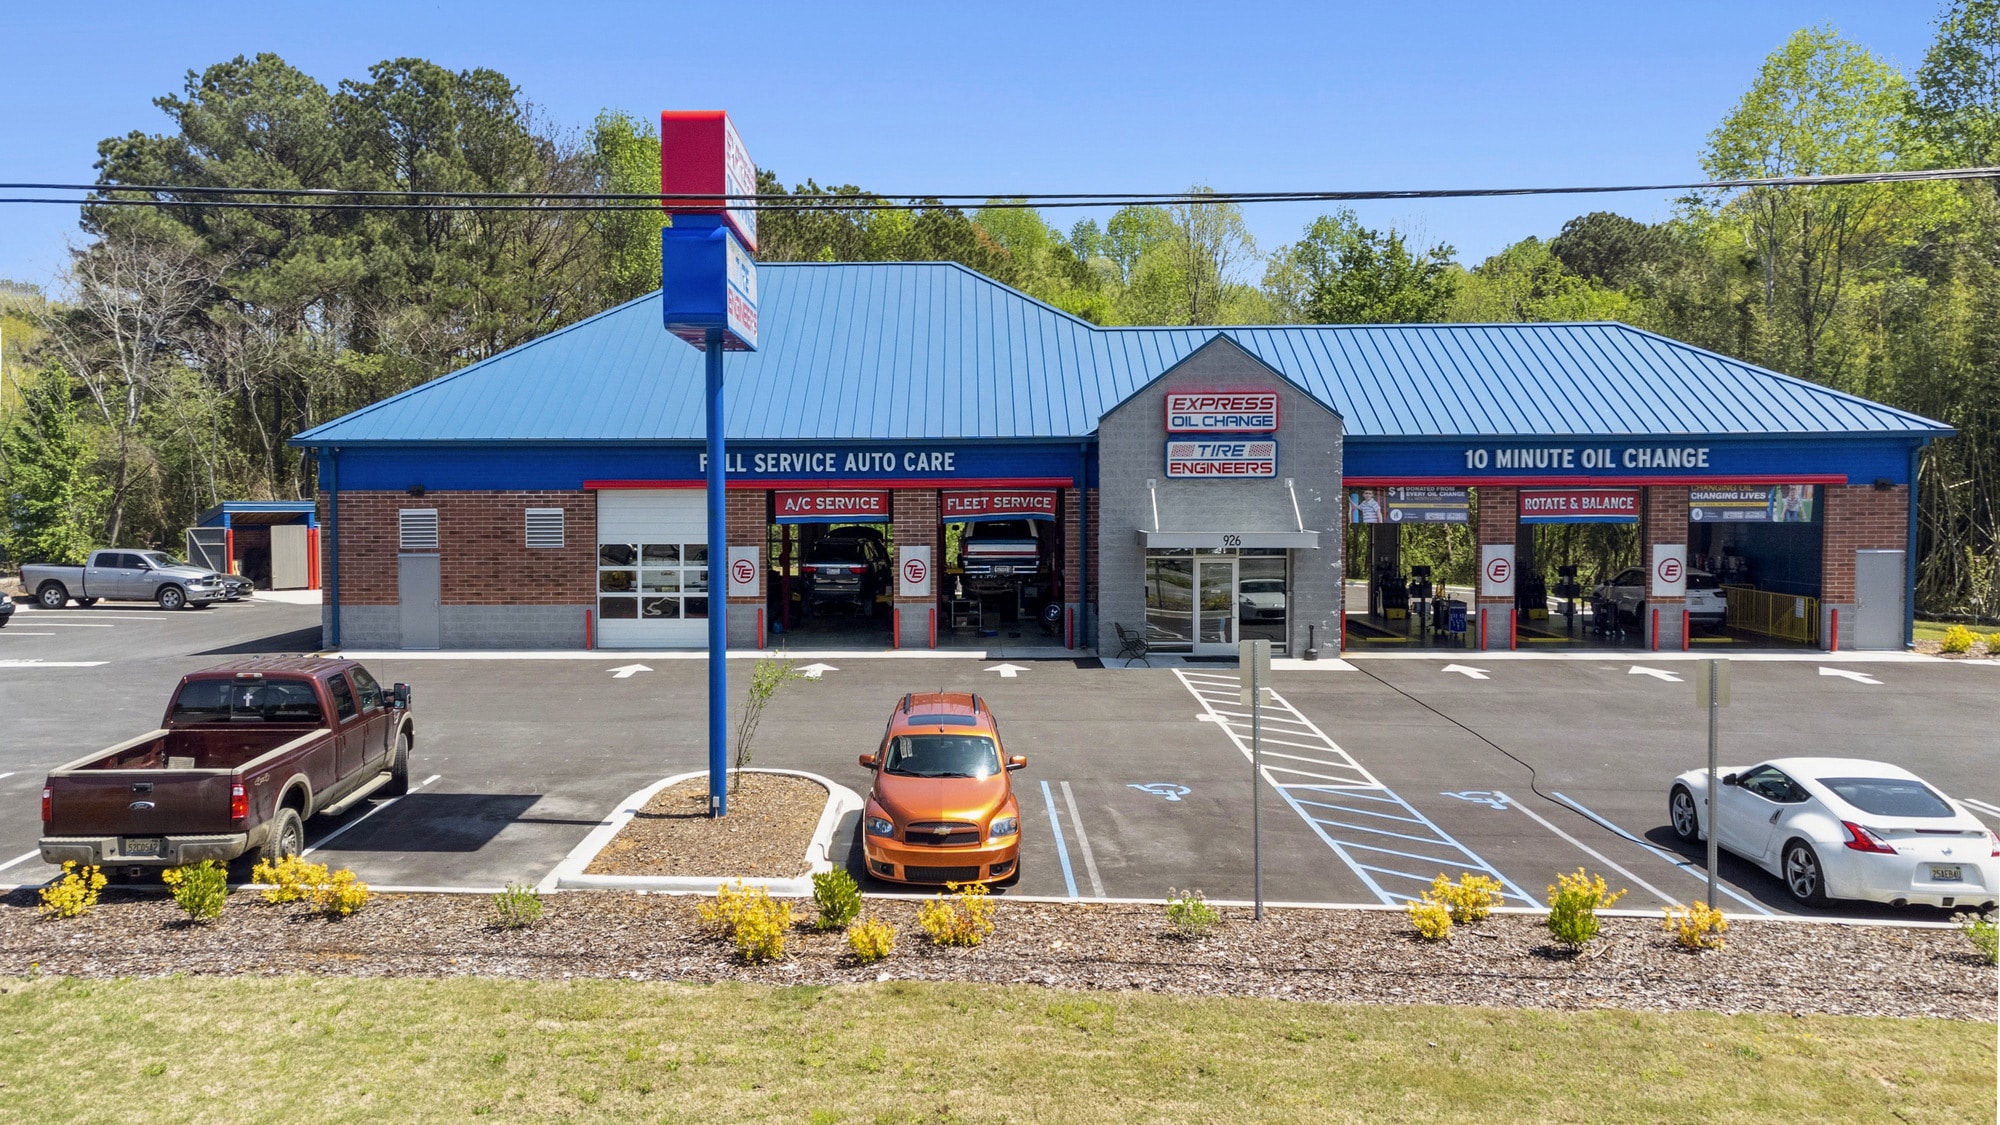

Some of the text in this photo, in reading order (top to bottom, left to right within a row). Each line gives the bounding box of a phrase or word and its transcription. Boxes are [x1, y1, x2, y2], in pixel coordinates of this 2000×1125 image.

[1172, 397, 1275, 410] EXPRESS
[1172, 415, 1274, 427] OIL CHANGE
[1198, 444, 1246, 457] TIRE
[699, 452, 955, 473] FLL SERVICE AUTO CARE
[1464, 448, 1710, 469] 10 MINUTE OIL CHANGE
[1170, 462, 1273, 474] ENGINEERS
[1691, 492, 1738, 500] CHANGING
[784, 497, 880, 512] A/C SERVICE
[947, 496, 1052, 511] FLEET SERVICE
[1524, 496, 1634, 511] ROTATE & BALANCE
[1223, 534, 1242, 546] 926
[1493, 564, 1508, 577] E
[1664, 564, 1679, 577] E
